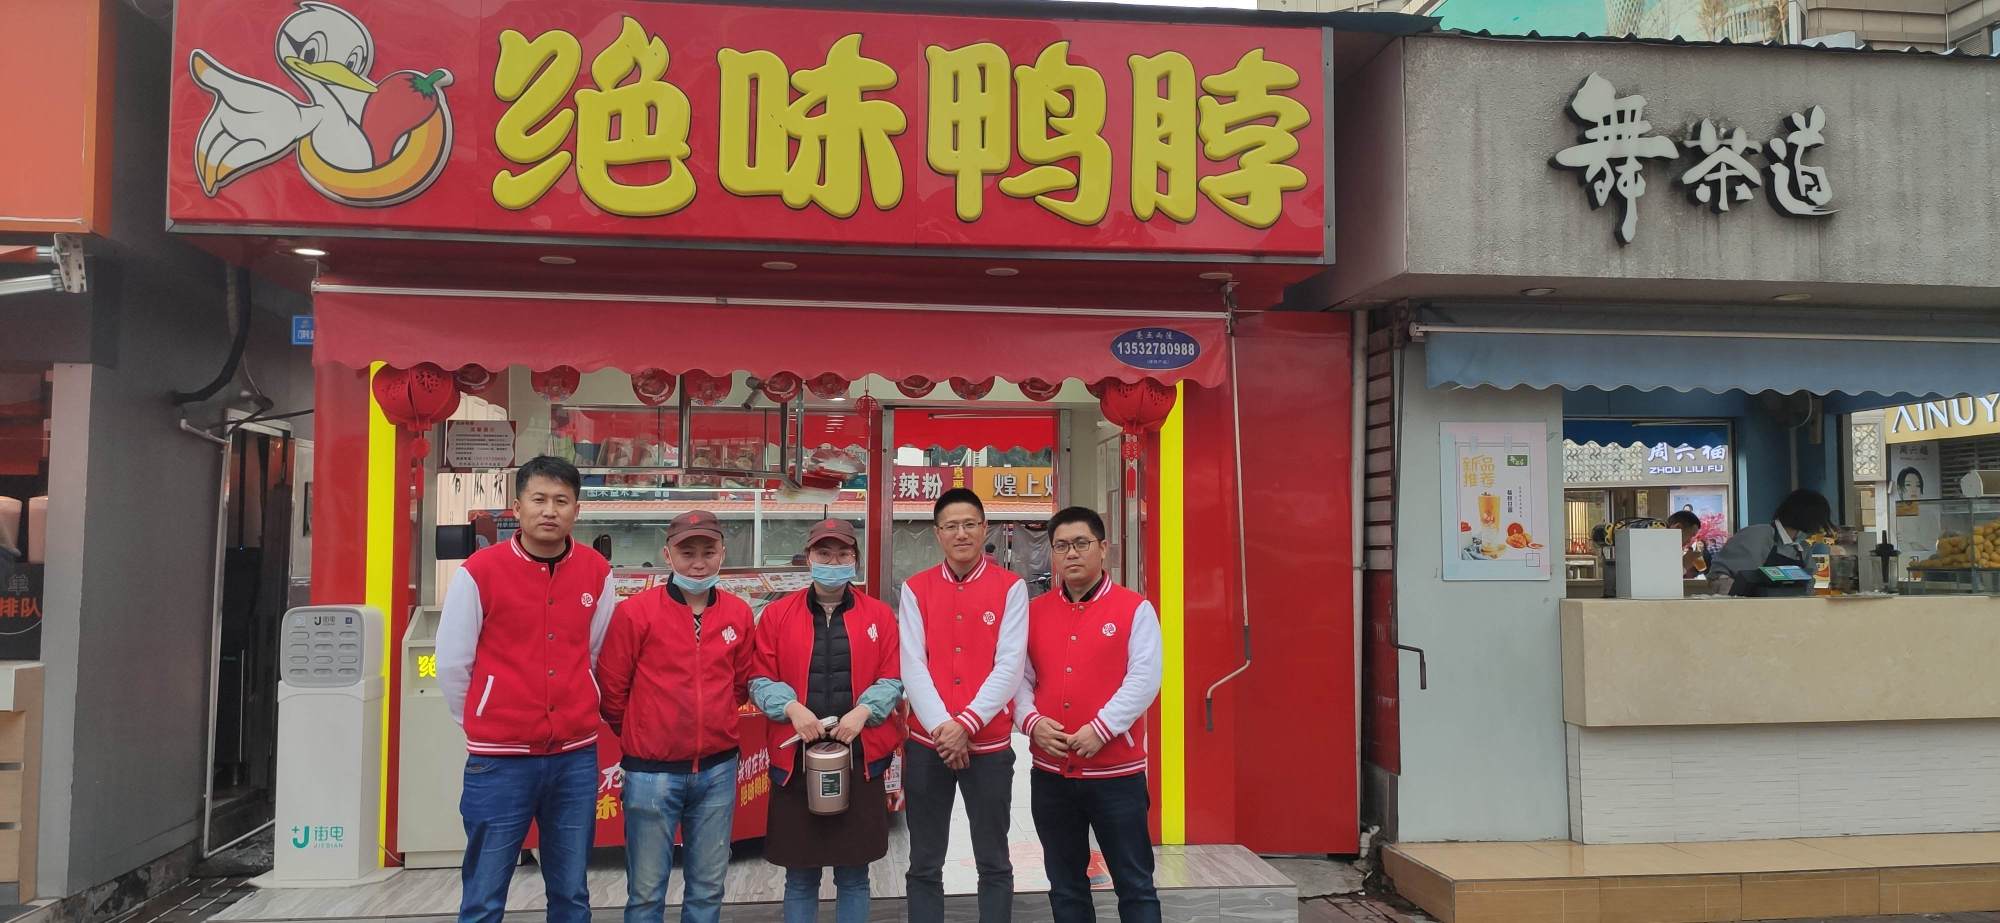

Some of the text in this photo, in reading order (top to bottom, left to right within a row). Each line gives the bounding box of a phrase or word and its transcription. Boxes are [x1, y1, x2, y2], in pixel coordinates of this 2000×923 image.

[491, 15, 1311, 229] 绝味鸭脖
[1555, 71, 1841, 243] 舞茶道
[1117, 342, 1195, 356] 13532780988
[1647, 441, 1726, 462] 周六福
[1649, 464, 1723, 474] ZHOU LIU FU
[892, 472, 943, 500] 辣粉
